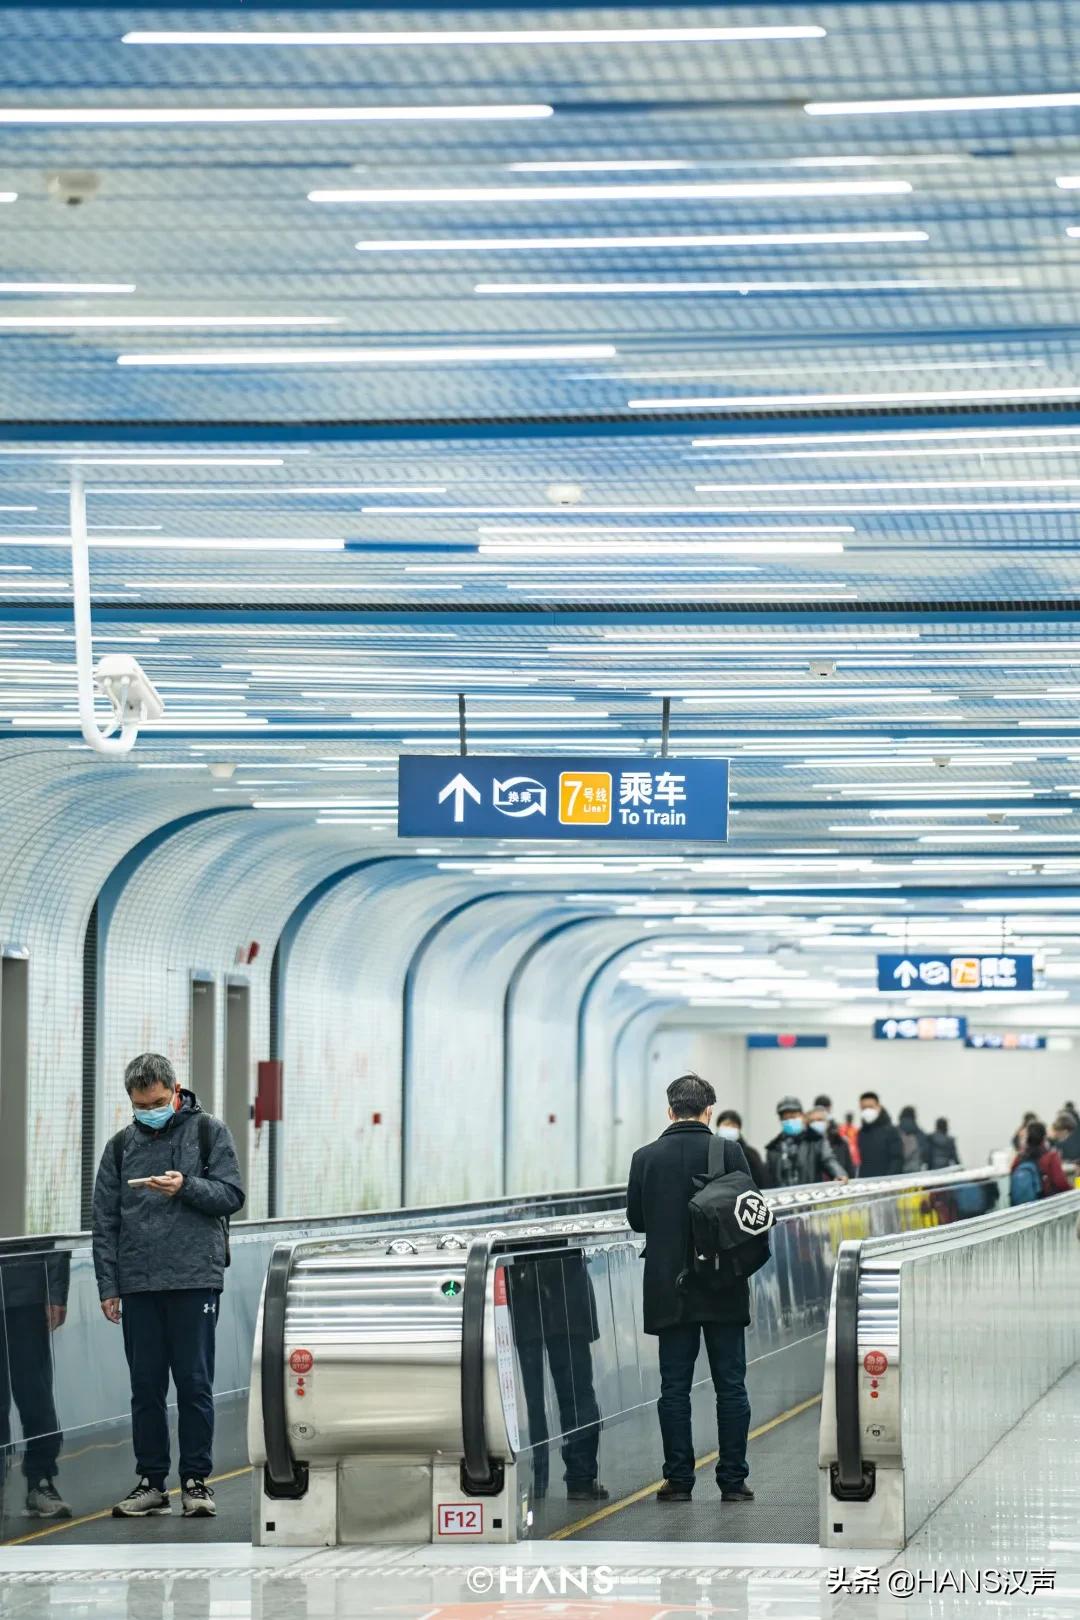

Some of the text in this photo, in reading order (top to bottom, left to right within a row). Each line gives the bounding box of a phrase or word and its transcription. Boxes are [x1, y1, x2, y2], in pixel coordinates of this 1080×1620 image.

[620, 771, 687, 807] 乘车
[619, 808, 686, 825] To Train
[444, 1511, 477, 1528] F12
